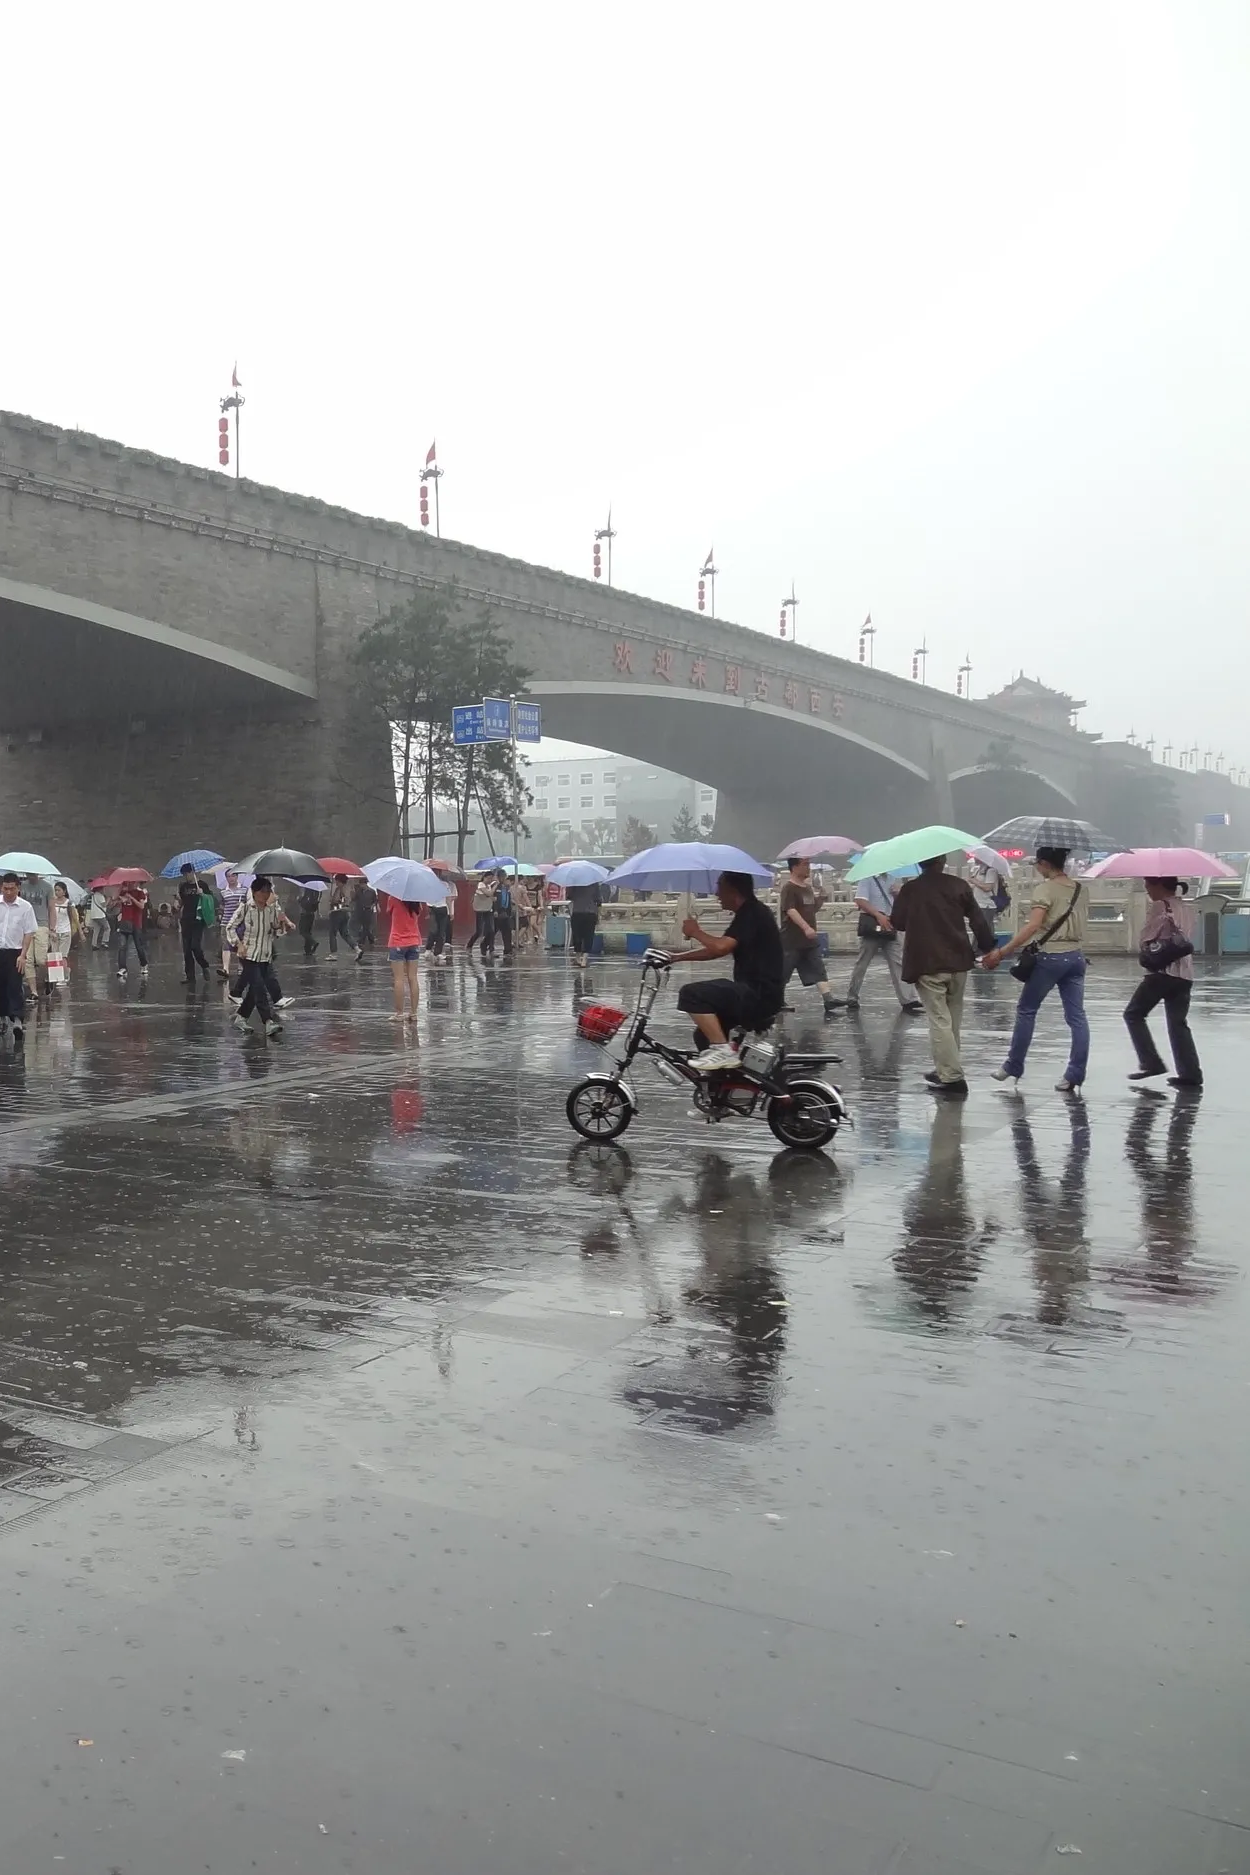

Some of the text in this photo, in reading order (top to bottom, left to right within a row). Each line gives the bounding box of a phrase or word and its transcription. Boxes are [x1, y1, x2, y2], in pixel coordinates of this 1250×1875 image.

[614, 641, 844, 718] 欢迎来到古都西安
